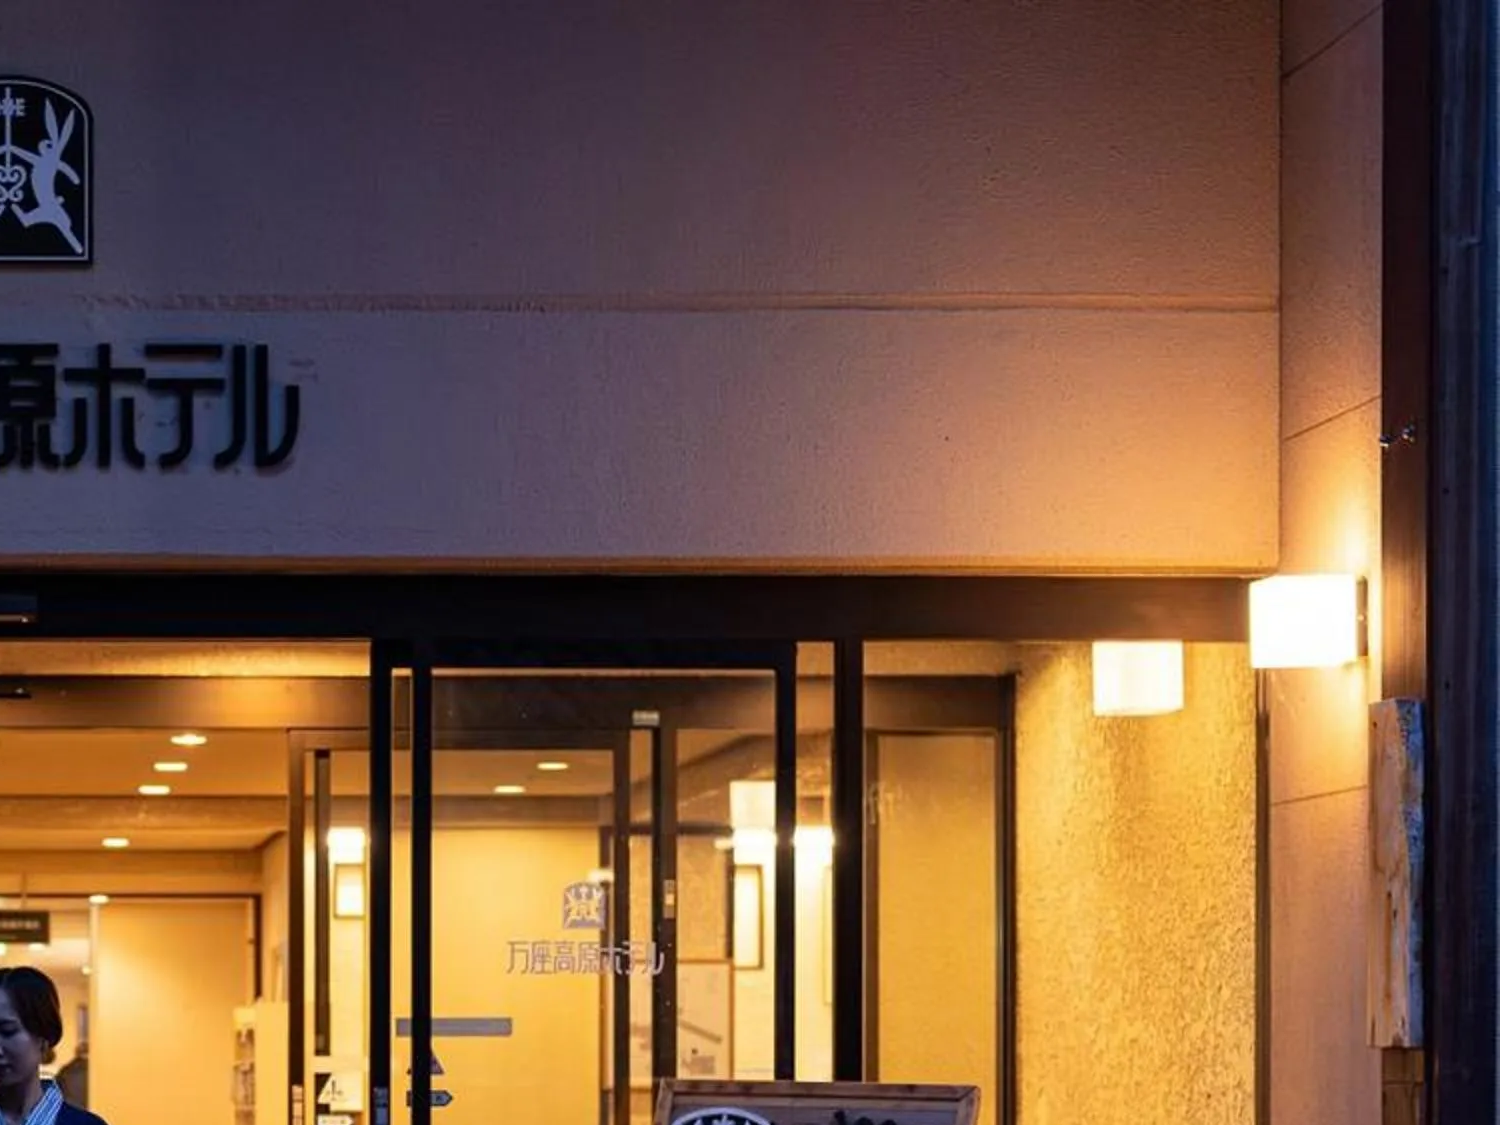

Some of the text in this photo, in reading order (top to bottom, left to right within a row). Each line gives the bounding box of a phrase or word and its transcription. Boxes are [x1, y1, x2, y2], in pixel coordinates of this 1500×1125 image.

[506, 941, 665, 975] 万座高原ホテル
